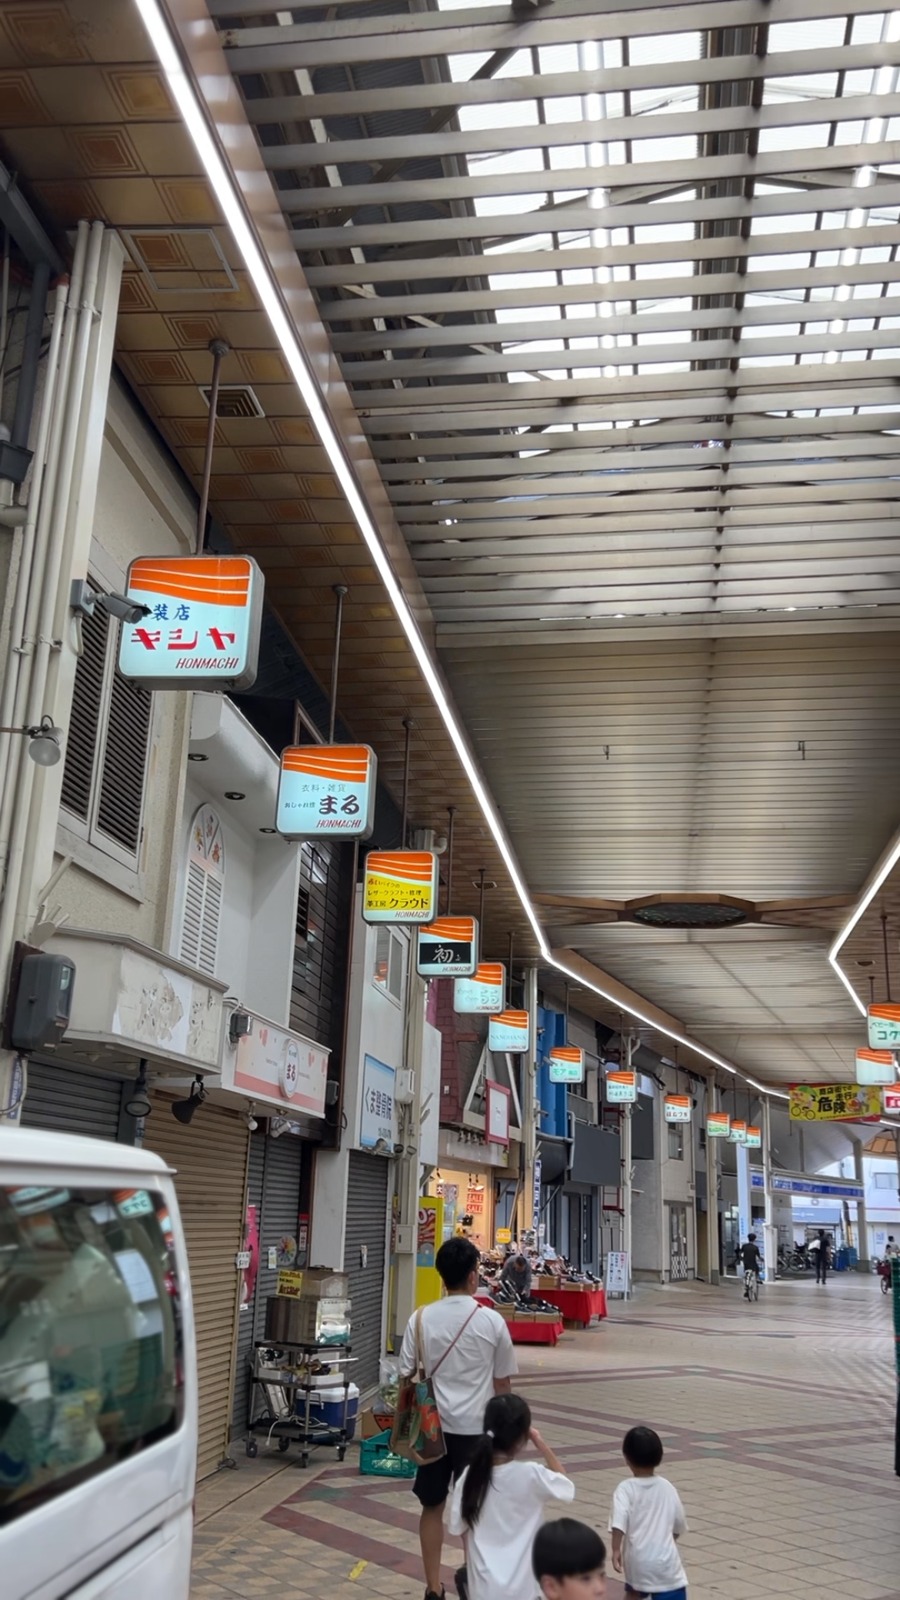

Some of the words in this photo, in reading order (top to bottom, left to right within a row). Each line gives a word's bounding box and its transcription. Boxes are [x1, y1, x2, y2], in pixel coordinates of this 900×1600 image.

[144, 603, 191, 621] 装店
[175, 656, 239, 669] HONMACHI
[318, 794, 360, 815] まる
[316, 819, 362, 829] HONMACHI
[389, 898, 429, 909] クラウド
[466, 1204, 483, 1213] SALE
